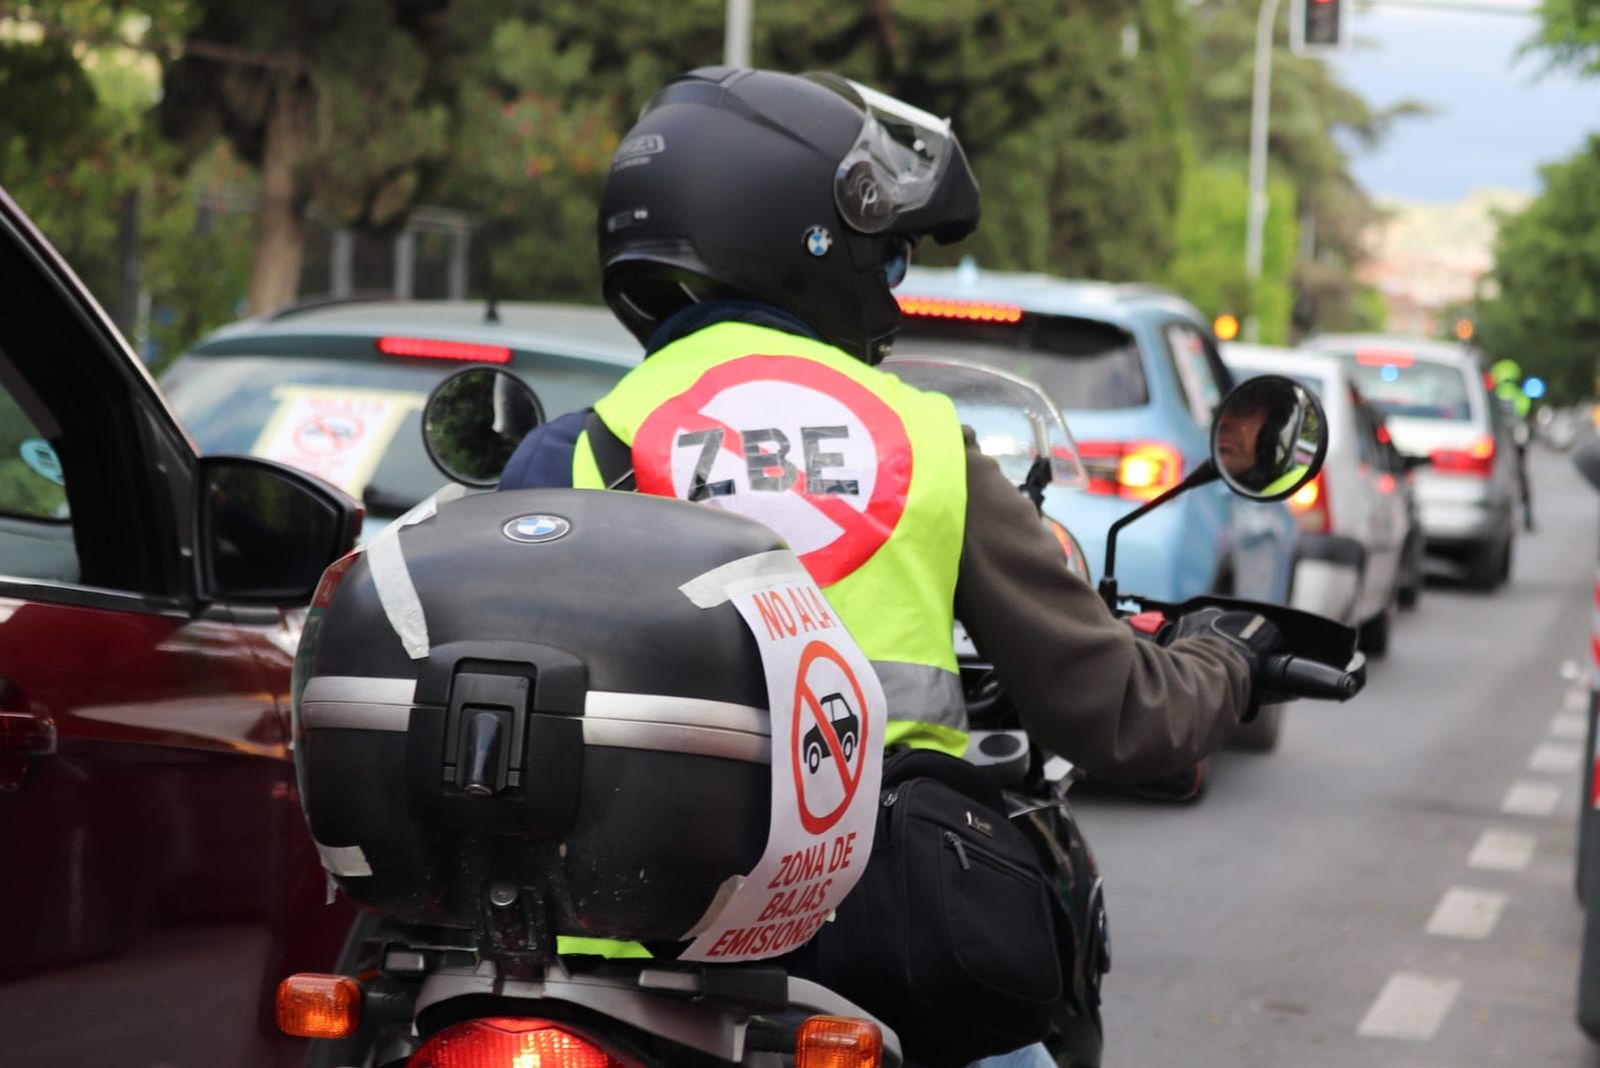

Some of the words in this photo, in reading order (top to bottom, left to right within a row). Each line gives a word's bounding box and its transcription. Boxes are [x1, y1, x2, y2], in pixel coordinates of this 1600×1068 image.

[678, 426, 859, 502] ZBE
[752, 590, 797, 641] NO
[786, 587, 817, 632] A
[797, 586, 837, 630] LA
[767, 842, 826, 889] ZONA
[828, 832, 857, 874] DE
[757, 879, 833, 922] BAJAS
